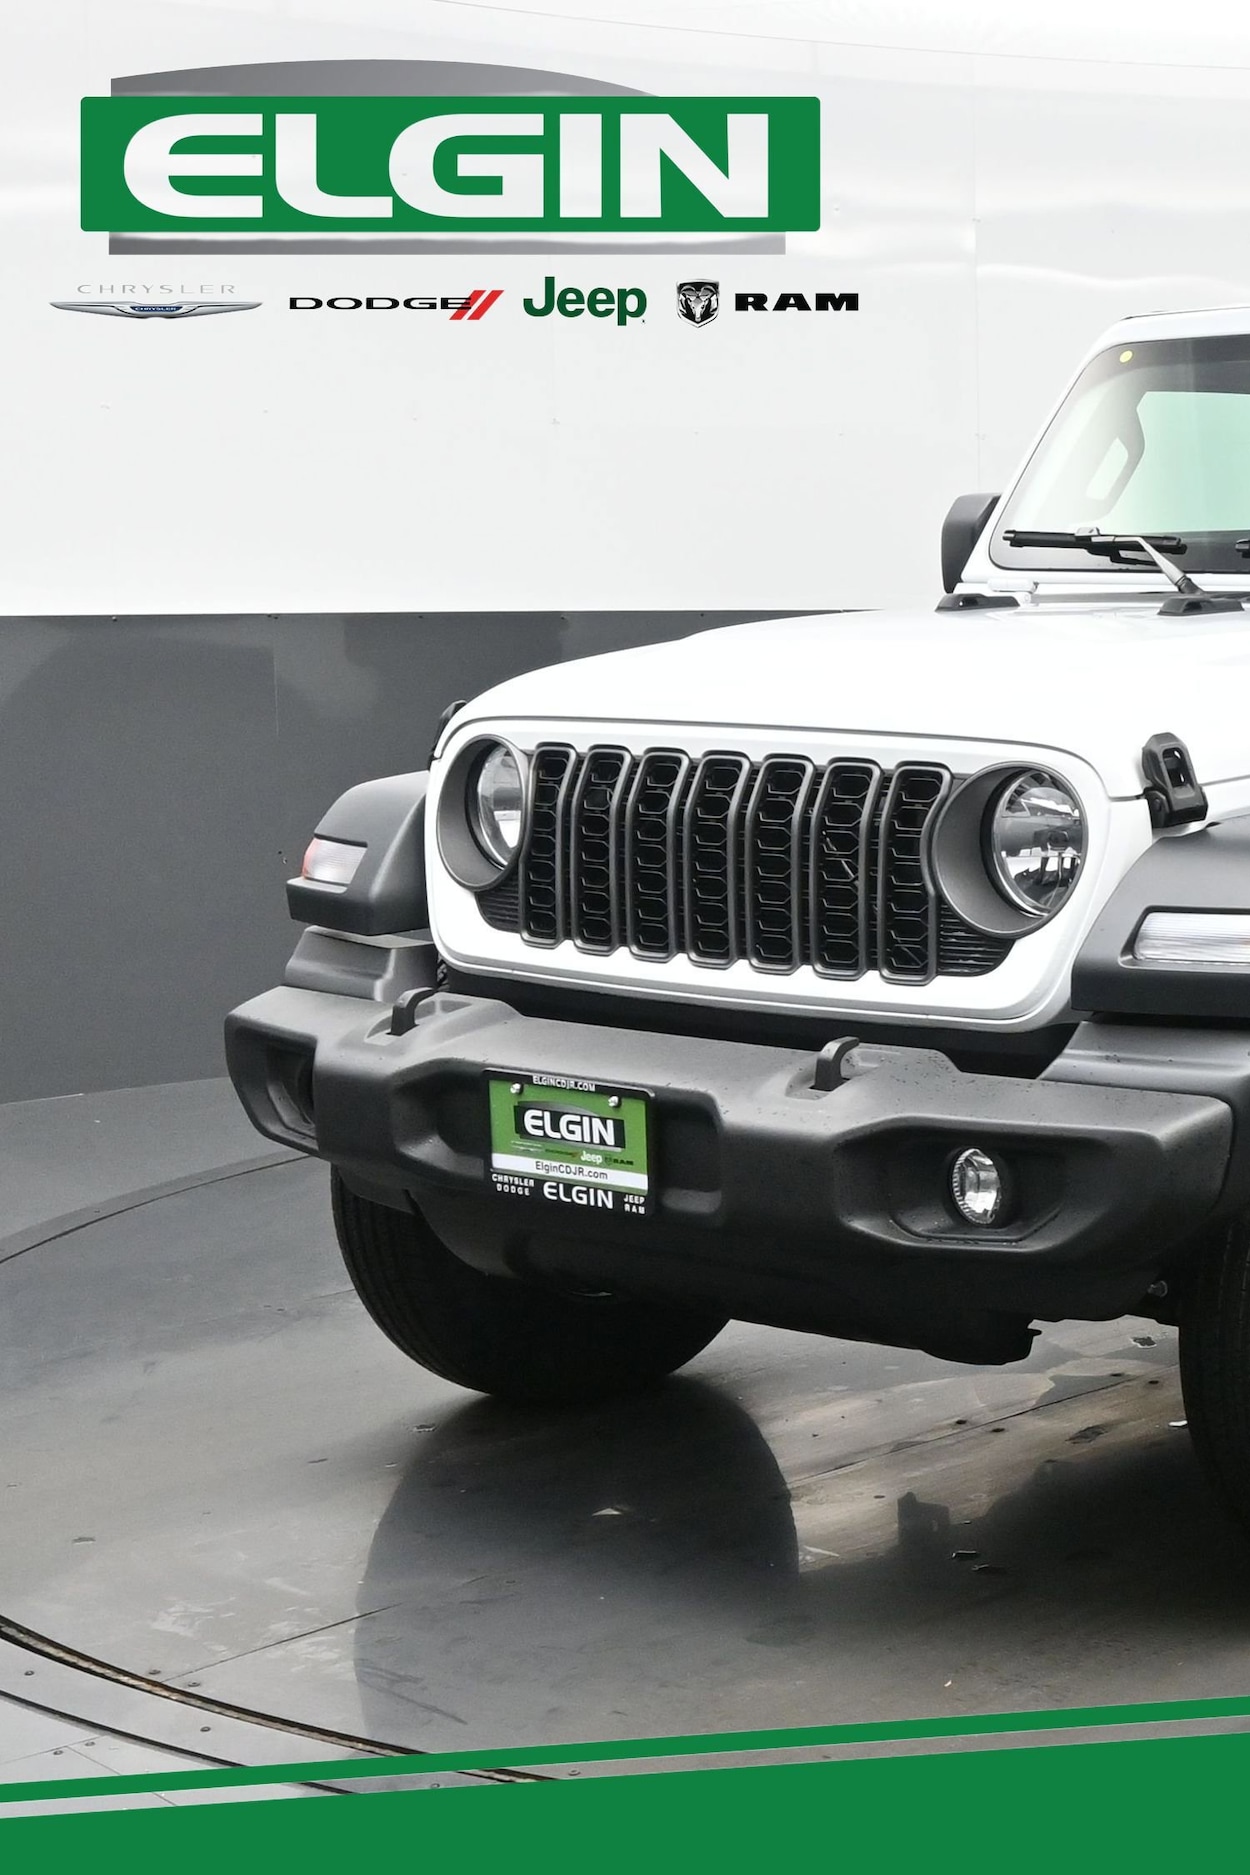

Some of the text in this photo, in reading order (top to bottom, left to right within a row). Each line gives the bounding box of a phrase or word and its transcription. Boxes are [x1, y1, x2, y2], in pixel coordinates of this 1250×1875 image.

[532, 1075, 596, 1092] ELGINCDJR.COM
[523, 1109, 616, 1146] ELGIN
[580, 1150, 603, 1165] Jeep
[535, 1160, 608, 1181] ElginCDJR.com
[491, 1173, 535, 1188] CHRYSLER
[496, 1183, 530, 1196] DODGE
[543, 1181, 614, 1210] ELGIN
[623, 1194, 645, 1205] JEEP
[624, 1203, 645, 1215] RAM
